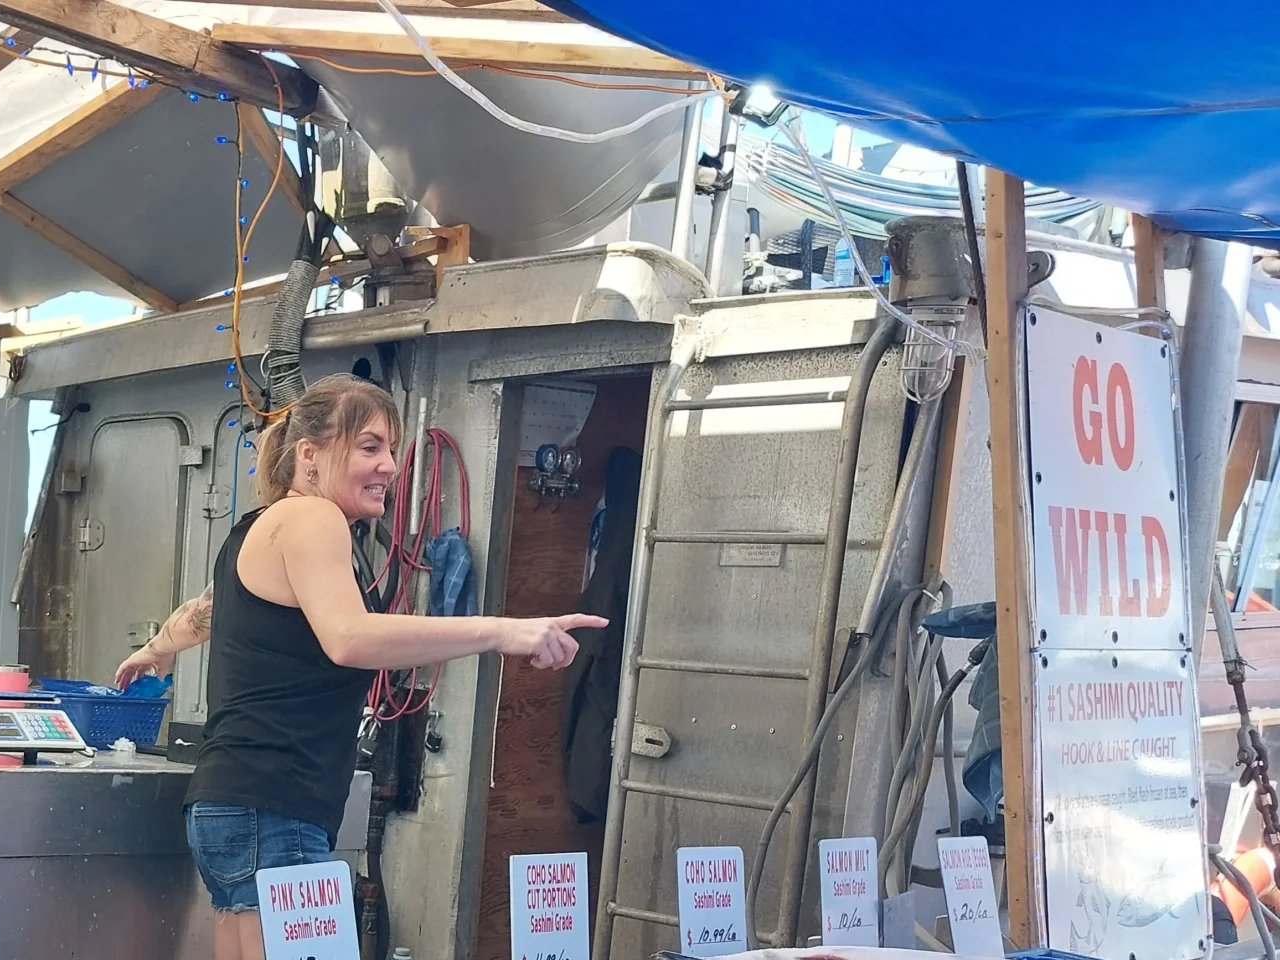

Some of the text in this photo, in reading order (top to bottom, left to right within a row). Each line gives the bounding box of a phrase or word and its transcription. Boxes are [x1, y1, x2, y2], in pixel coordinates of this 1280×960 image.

[1073, 355, 1135, 471] GO
[1048, 505, 1171, 617] WILD
[1047, 681, 1184, 723] #1 SASHIMI QUALITY
[1061, 741, 1094, 766] HOOK
[1096, 743, 1105, 763] &
[1132, 736, 1177, 760] CAUGHT
[527, 862, 576, 885] COHO SALMON
[685, 859, 737, 884] COHO SALMON
[827, 850, 853, 874] SALMON
[270, 877, 341, 912] PINK SALMON
[527, 886, 576, 909] CUT PORTIONS
[833, 878, 851, 896] Sashimi
[694, 890, 731, 909] Sashimi Grade
[530, 911, 573, 933] Sashimi Grade
[827, 916, 831, 933] $
[954, 908, 958, 923] $
[283, 914, 337, 941] Sashimi Grade
[687, 928, 692, 948] $
